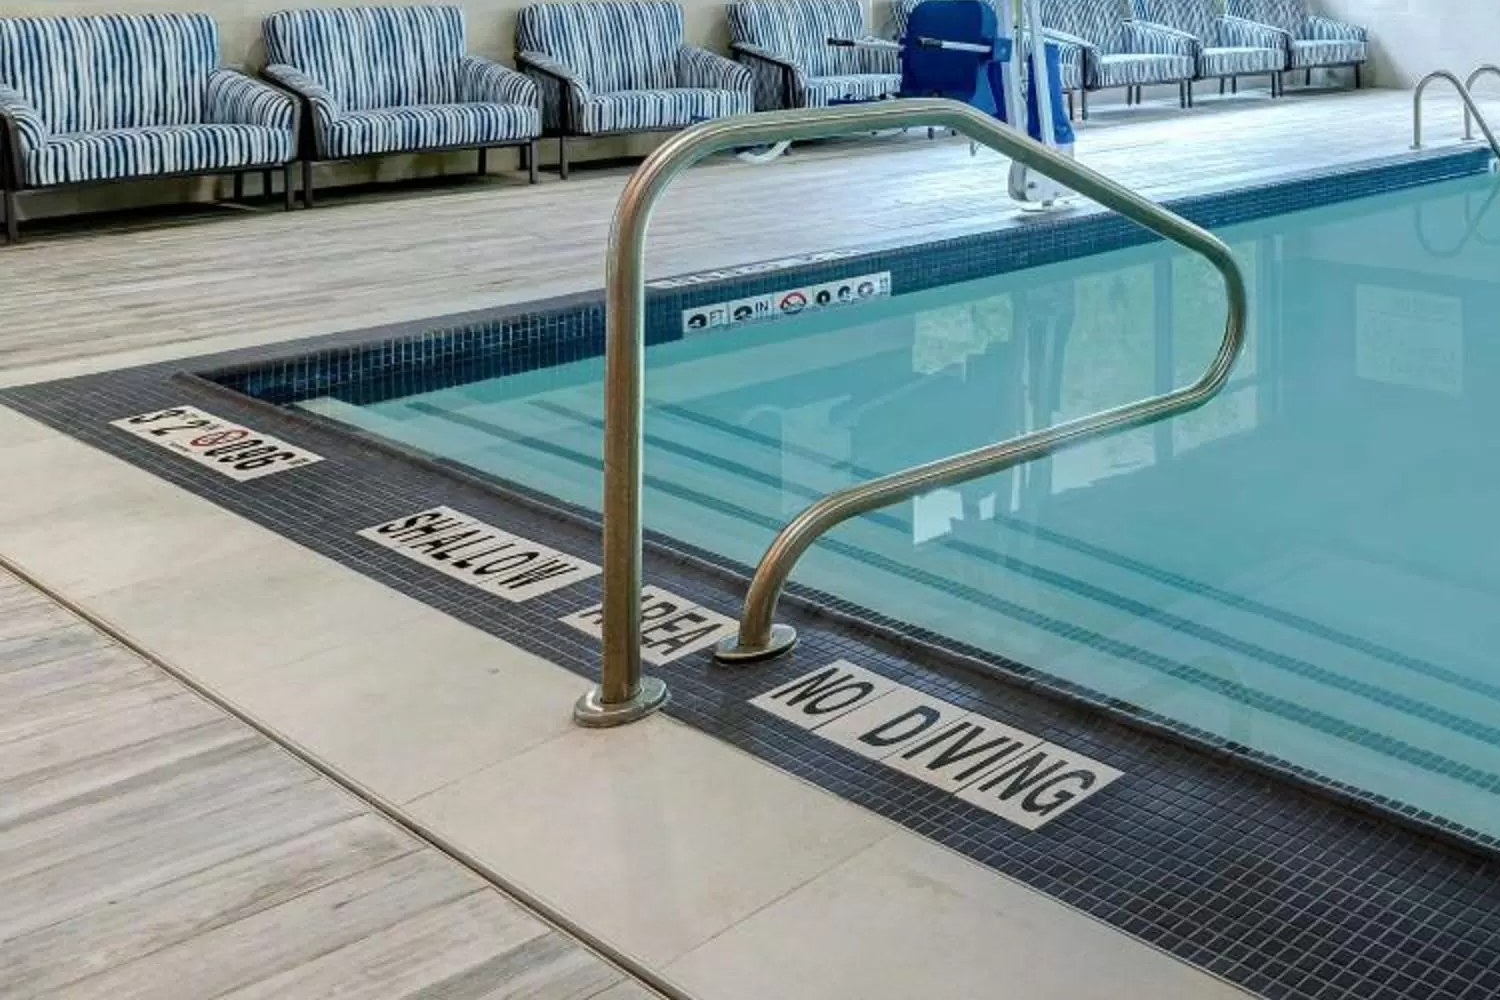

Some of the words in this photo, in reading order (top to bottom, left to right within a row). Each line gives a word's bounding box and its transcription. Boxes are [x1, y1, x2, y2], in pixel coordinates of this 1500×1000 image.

[377, 512, 580, 589] SHALLOW
[771, 667, 874, 716] NO
[856, 704, 1098, 817] DIVING
